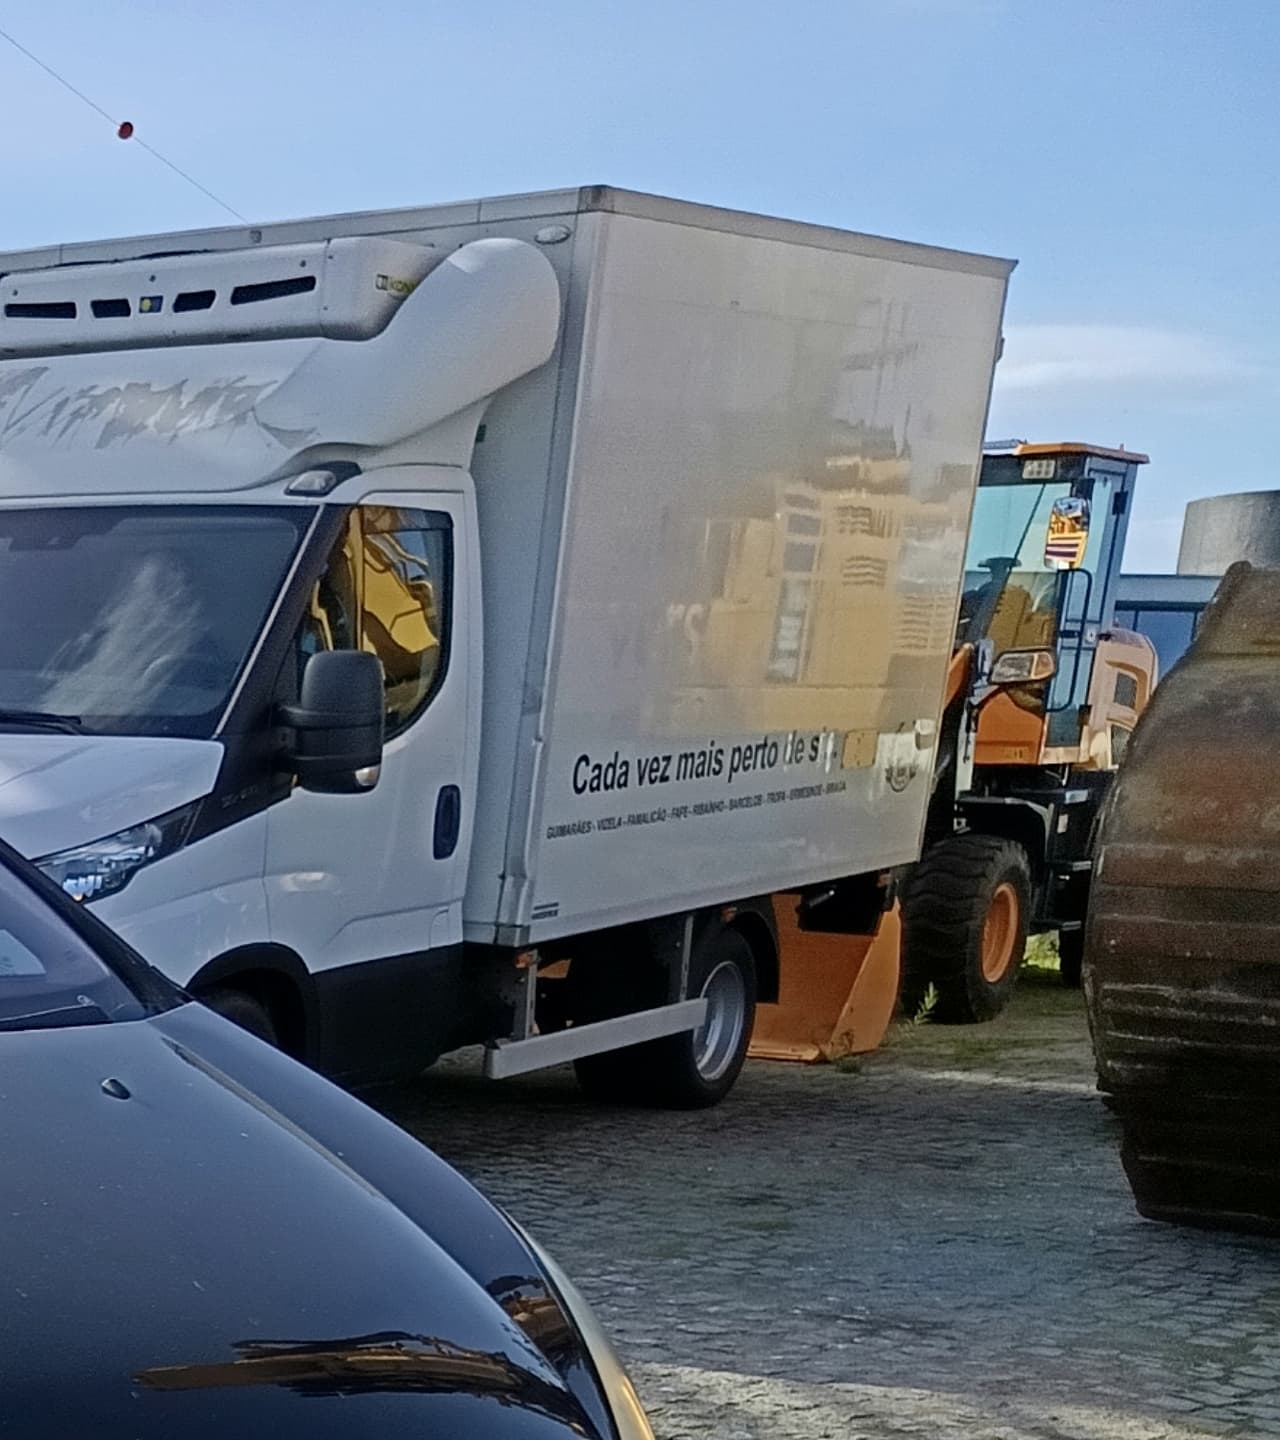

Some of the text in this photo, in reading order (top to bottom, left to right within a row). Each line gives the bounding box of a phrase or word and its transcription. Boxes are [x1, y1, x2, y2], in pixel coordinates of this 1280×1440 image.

[572, 750, 630, 796] Cada
[637, 755, 672, 787] vez
[675, 739, 724, 781] mais
[727, 735, 778, 784] perto
